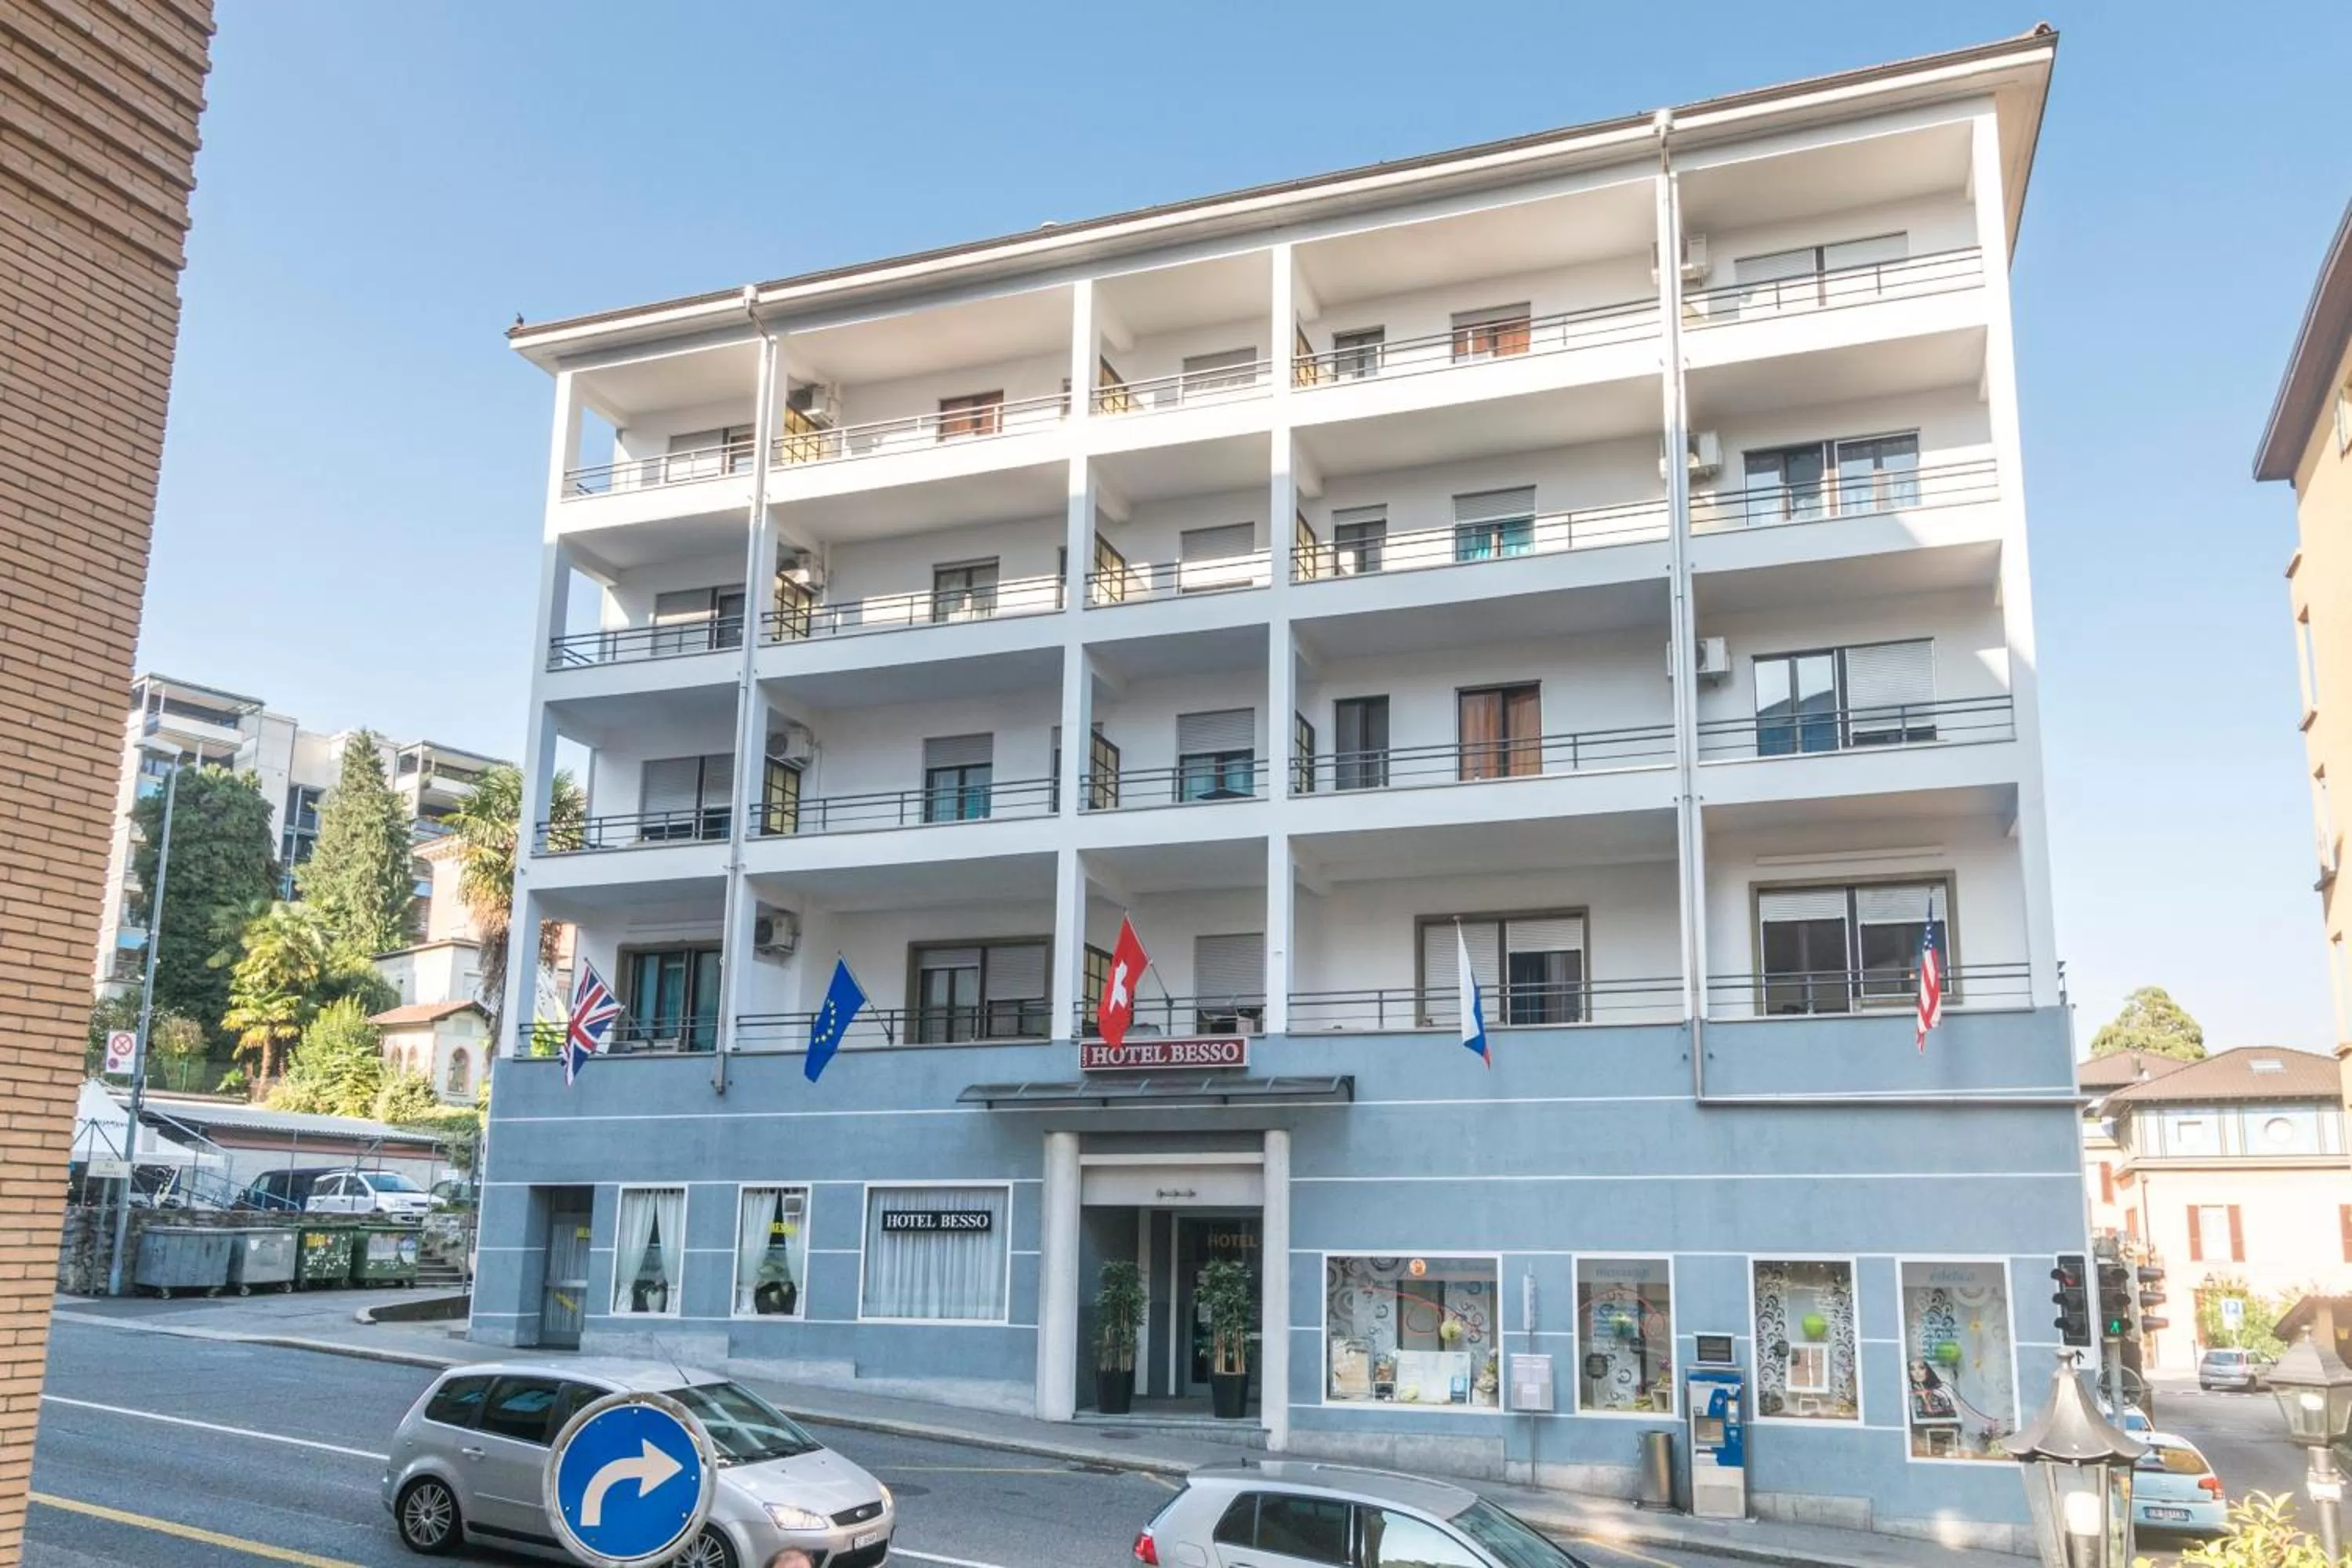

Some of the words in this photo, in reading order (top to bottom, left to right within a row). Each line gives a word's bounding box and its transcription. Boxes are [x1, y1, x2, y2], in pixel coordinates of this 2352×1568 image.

[1091, 1045, 1167, 1065] HOTEL
[1171, 1043, 1240, 1062] BESSO
[887, 1214, 936, 1228] HOTEL
[941, 1214, 989, 1228] BESSO
[1207, 1234, 1258, 1248] HOTEL
